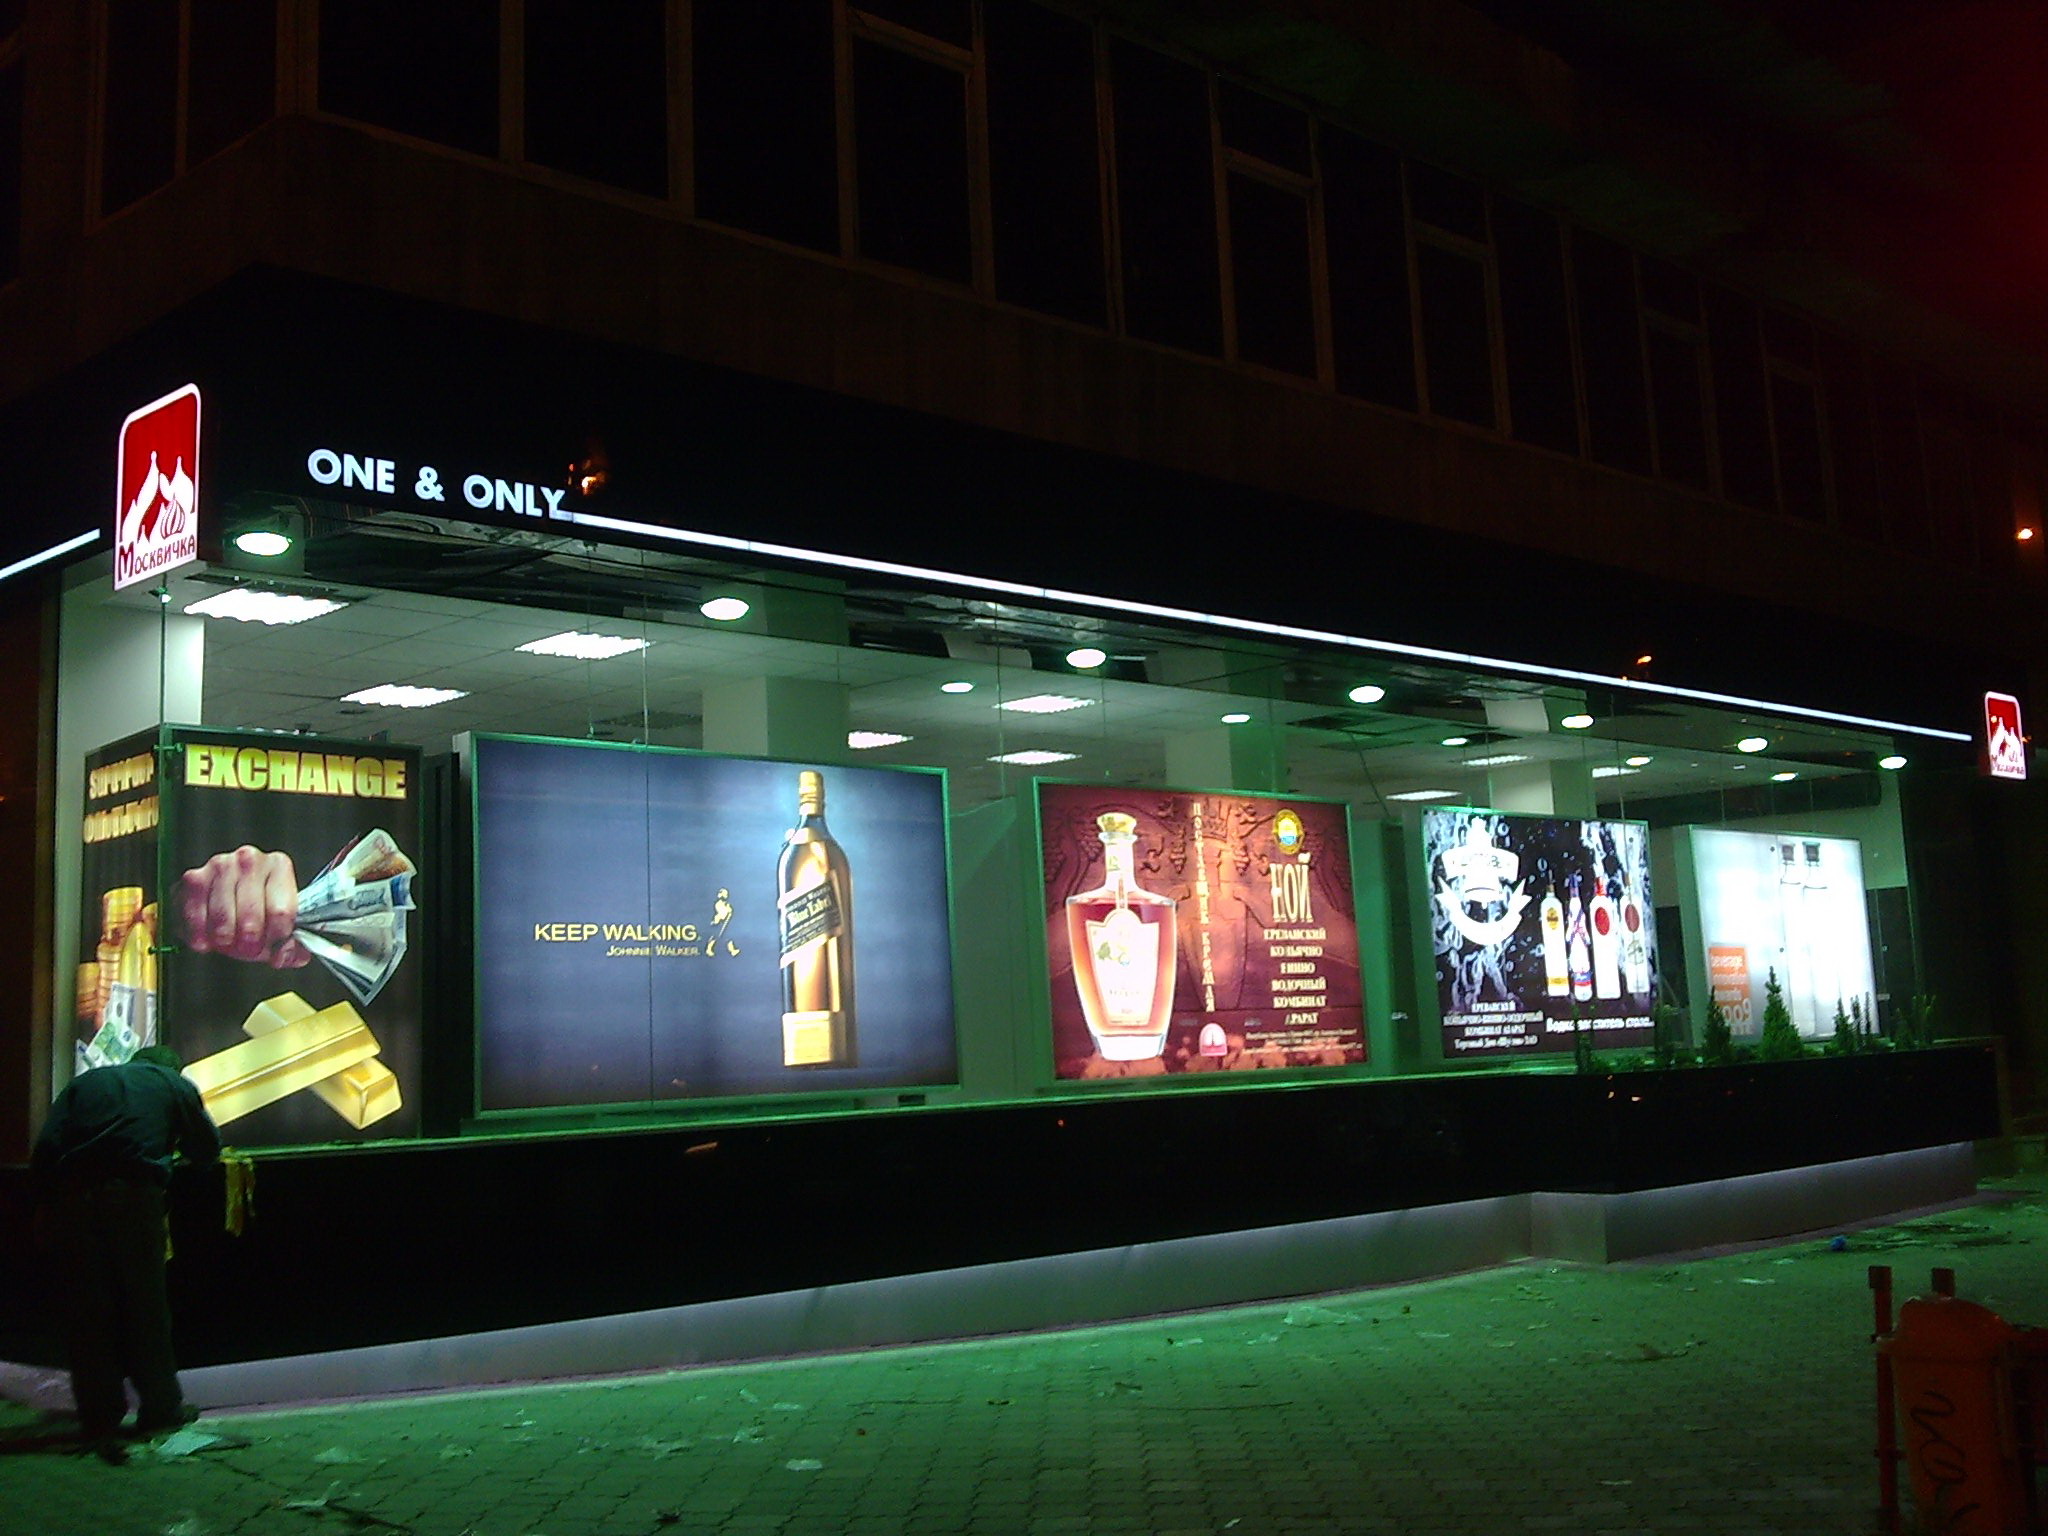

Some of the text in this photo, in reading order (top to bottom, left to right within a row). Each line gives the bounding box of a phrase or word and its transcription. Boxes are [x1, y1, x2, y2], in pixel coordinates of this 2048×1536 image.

[306, 448, 566, 519] ONE & ONLY
[184, 743, 407, 800] EXCHANGE
[1269, 852, 1314, 923] НОЙ
[534, 923, 599, 942] KEEP
